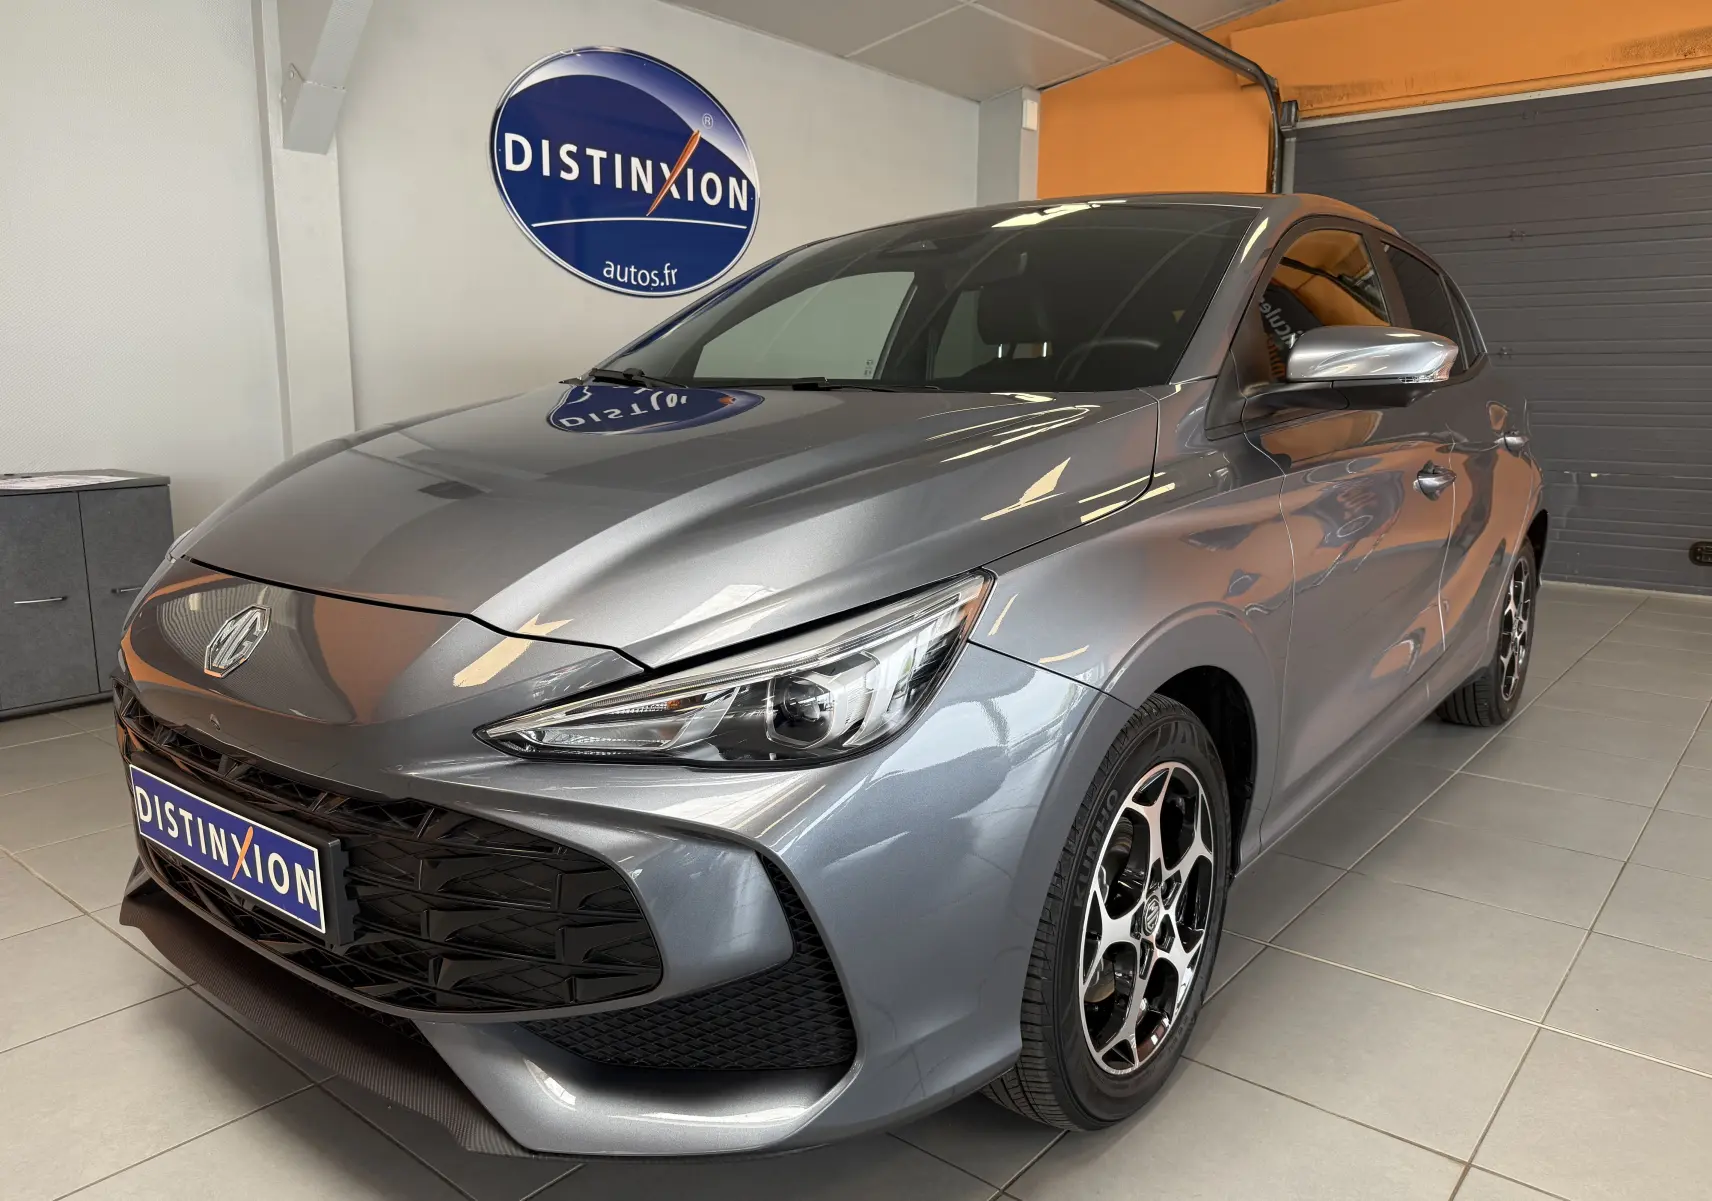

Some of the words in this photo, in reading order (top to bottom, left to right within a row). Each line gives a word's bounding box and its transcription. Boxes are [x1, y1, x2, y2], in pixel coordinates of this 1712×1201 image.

[505, 130, 747, 214] DISTINXION
[603, 260, 677, 287] autos.fr
[211, 608, 262, 670] MG
[135, 785, 317, 911] DISTINXION
[1073, 789, 1119, 907] KUMHO
